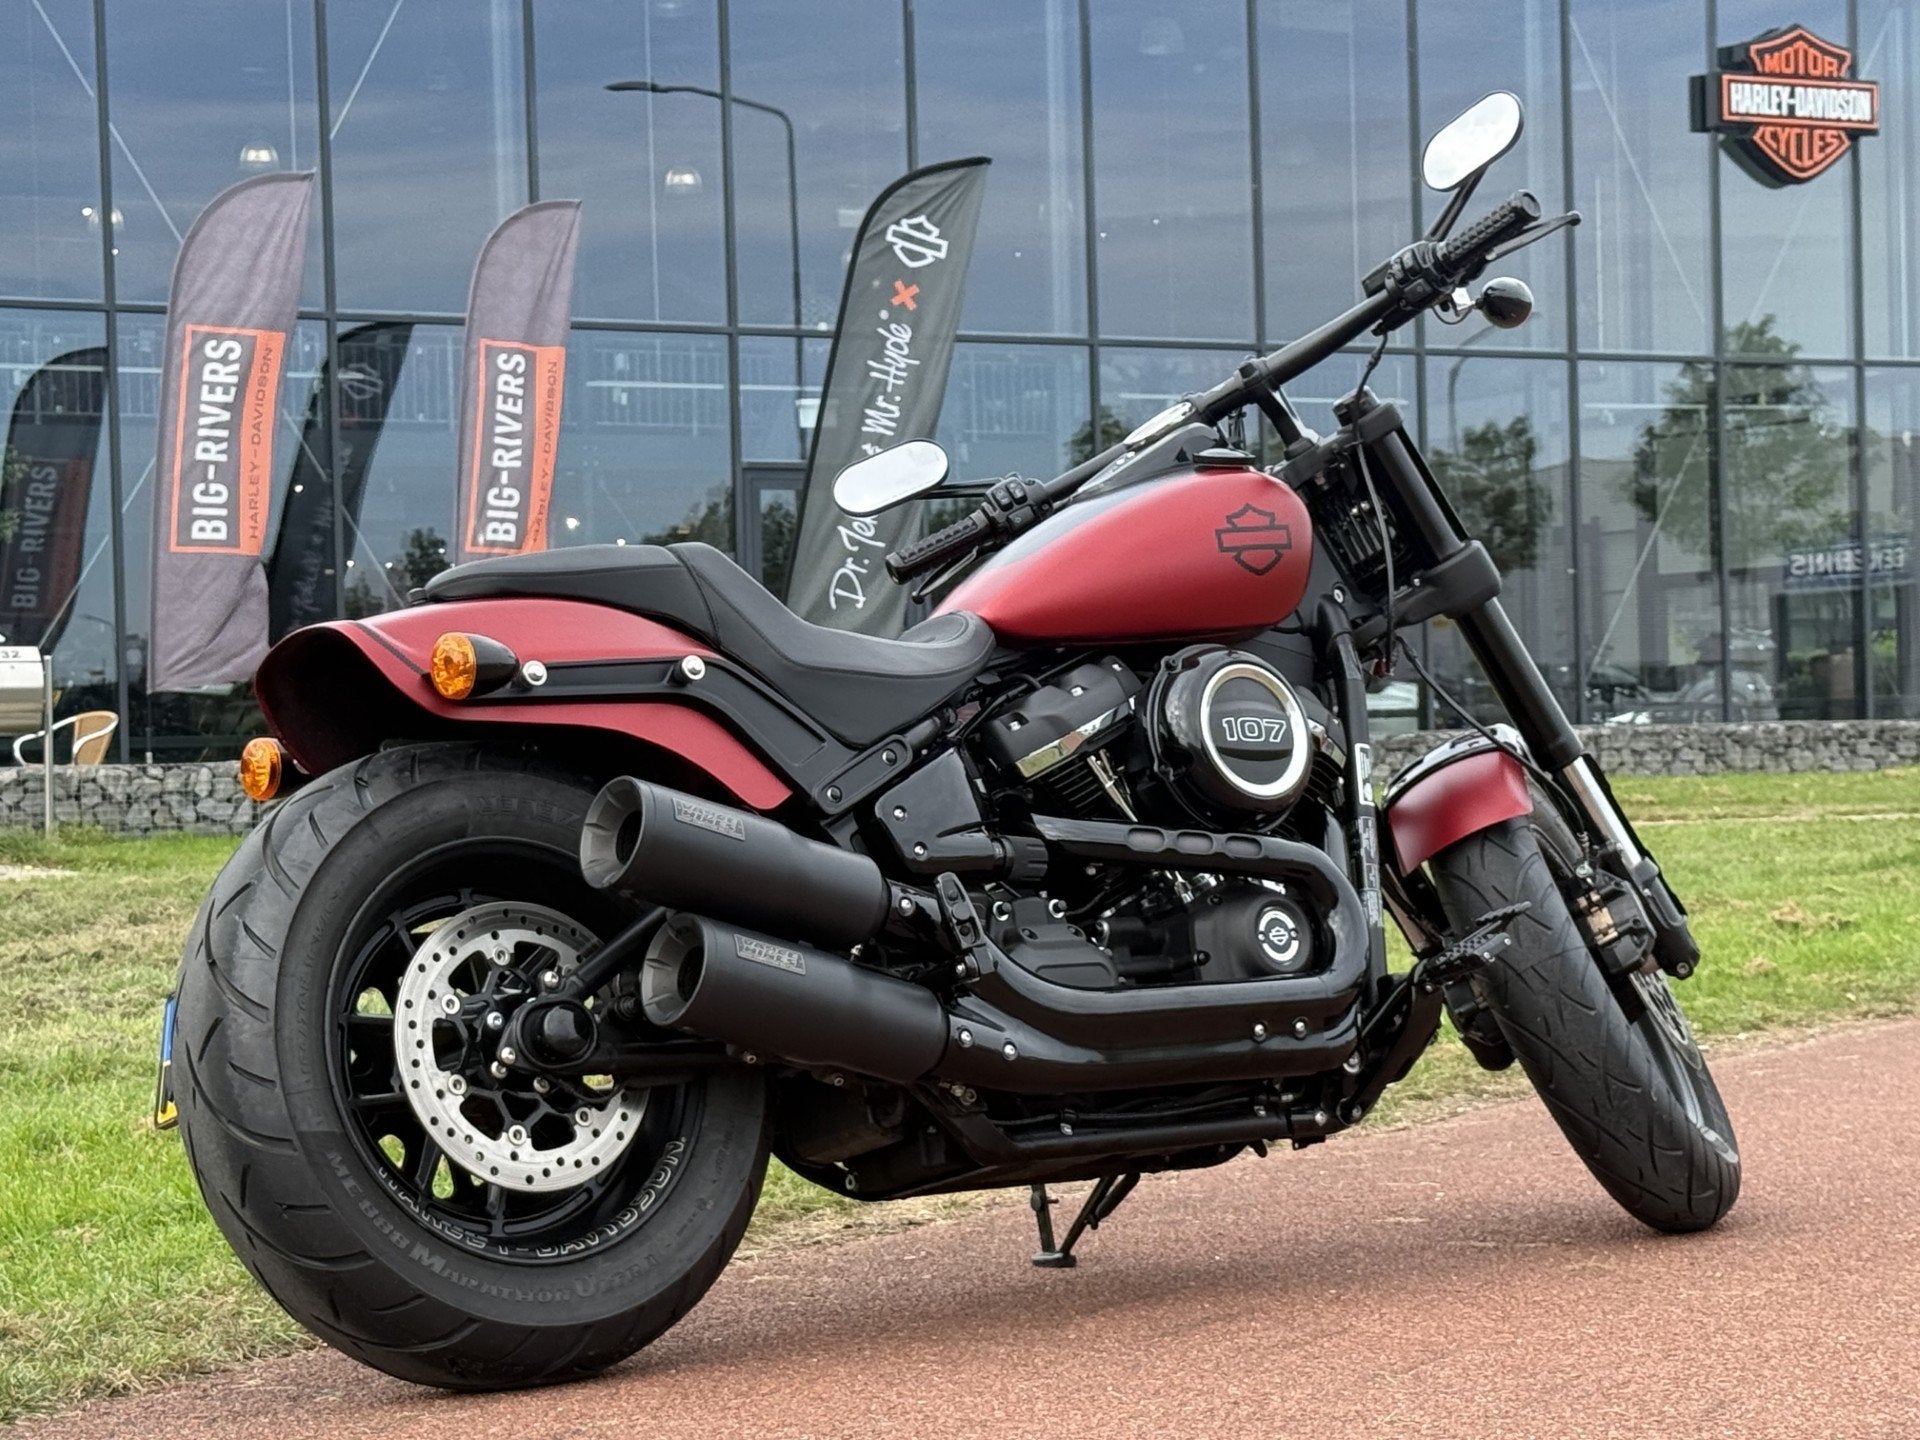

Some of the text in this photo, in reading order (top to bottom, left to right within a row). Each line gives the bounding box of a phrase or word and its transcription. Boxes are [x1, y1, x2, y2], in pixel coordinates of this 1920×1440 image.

[1763, 40, 1838, 78] MOTOR
[1729, 81, 1873, 122] HARLEY-DAVIDSON
[1763, 126, 1842, 168] CYCLES
[866, 322, 921, 393] Hyde
[190, 339, 242, 541] BIG-RIVERS
[861, 395, 901, 436] Mr.
[249, 347, 273, 540] HARLEY-DAVIDSON
[485, 353, 527, 543] BIG-RIVERS
[11, 466, 58, 609] BIG-RIVERS
[829, 557, 870, 610] Dr.
[1222, 717, 1287, 743] 107
